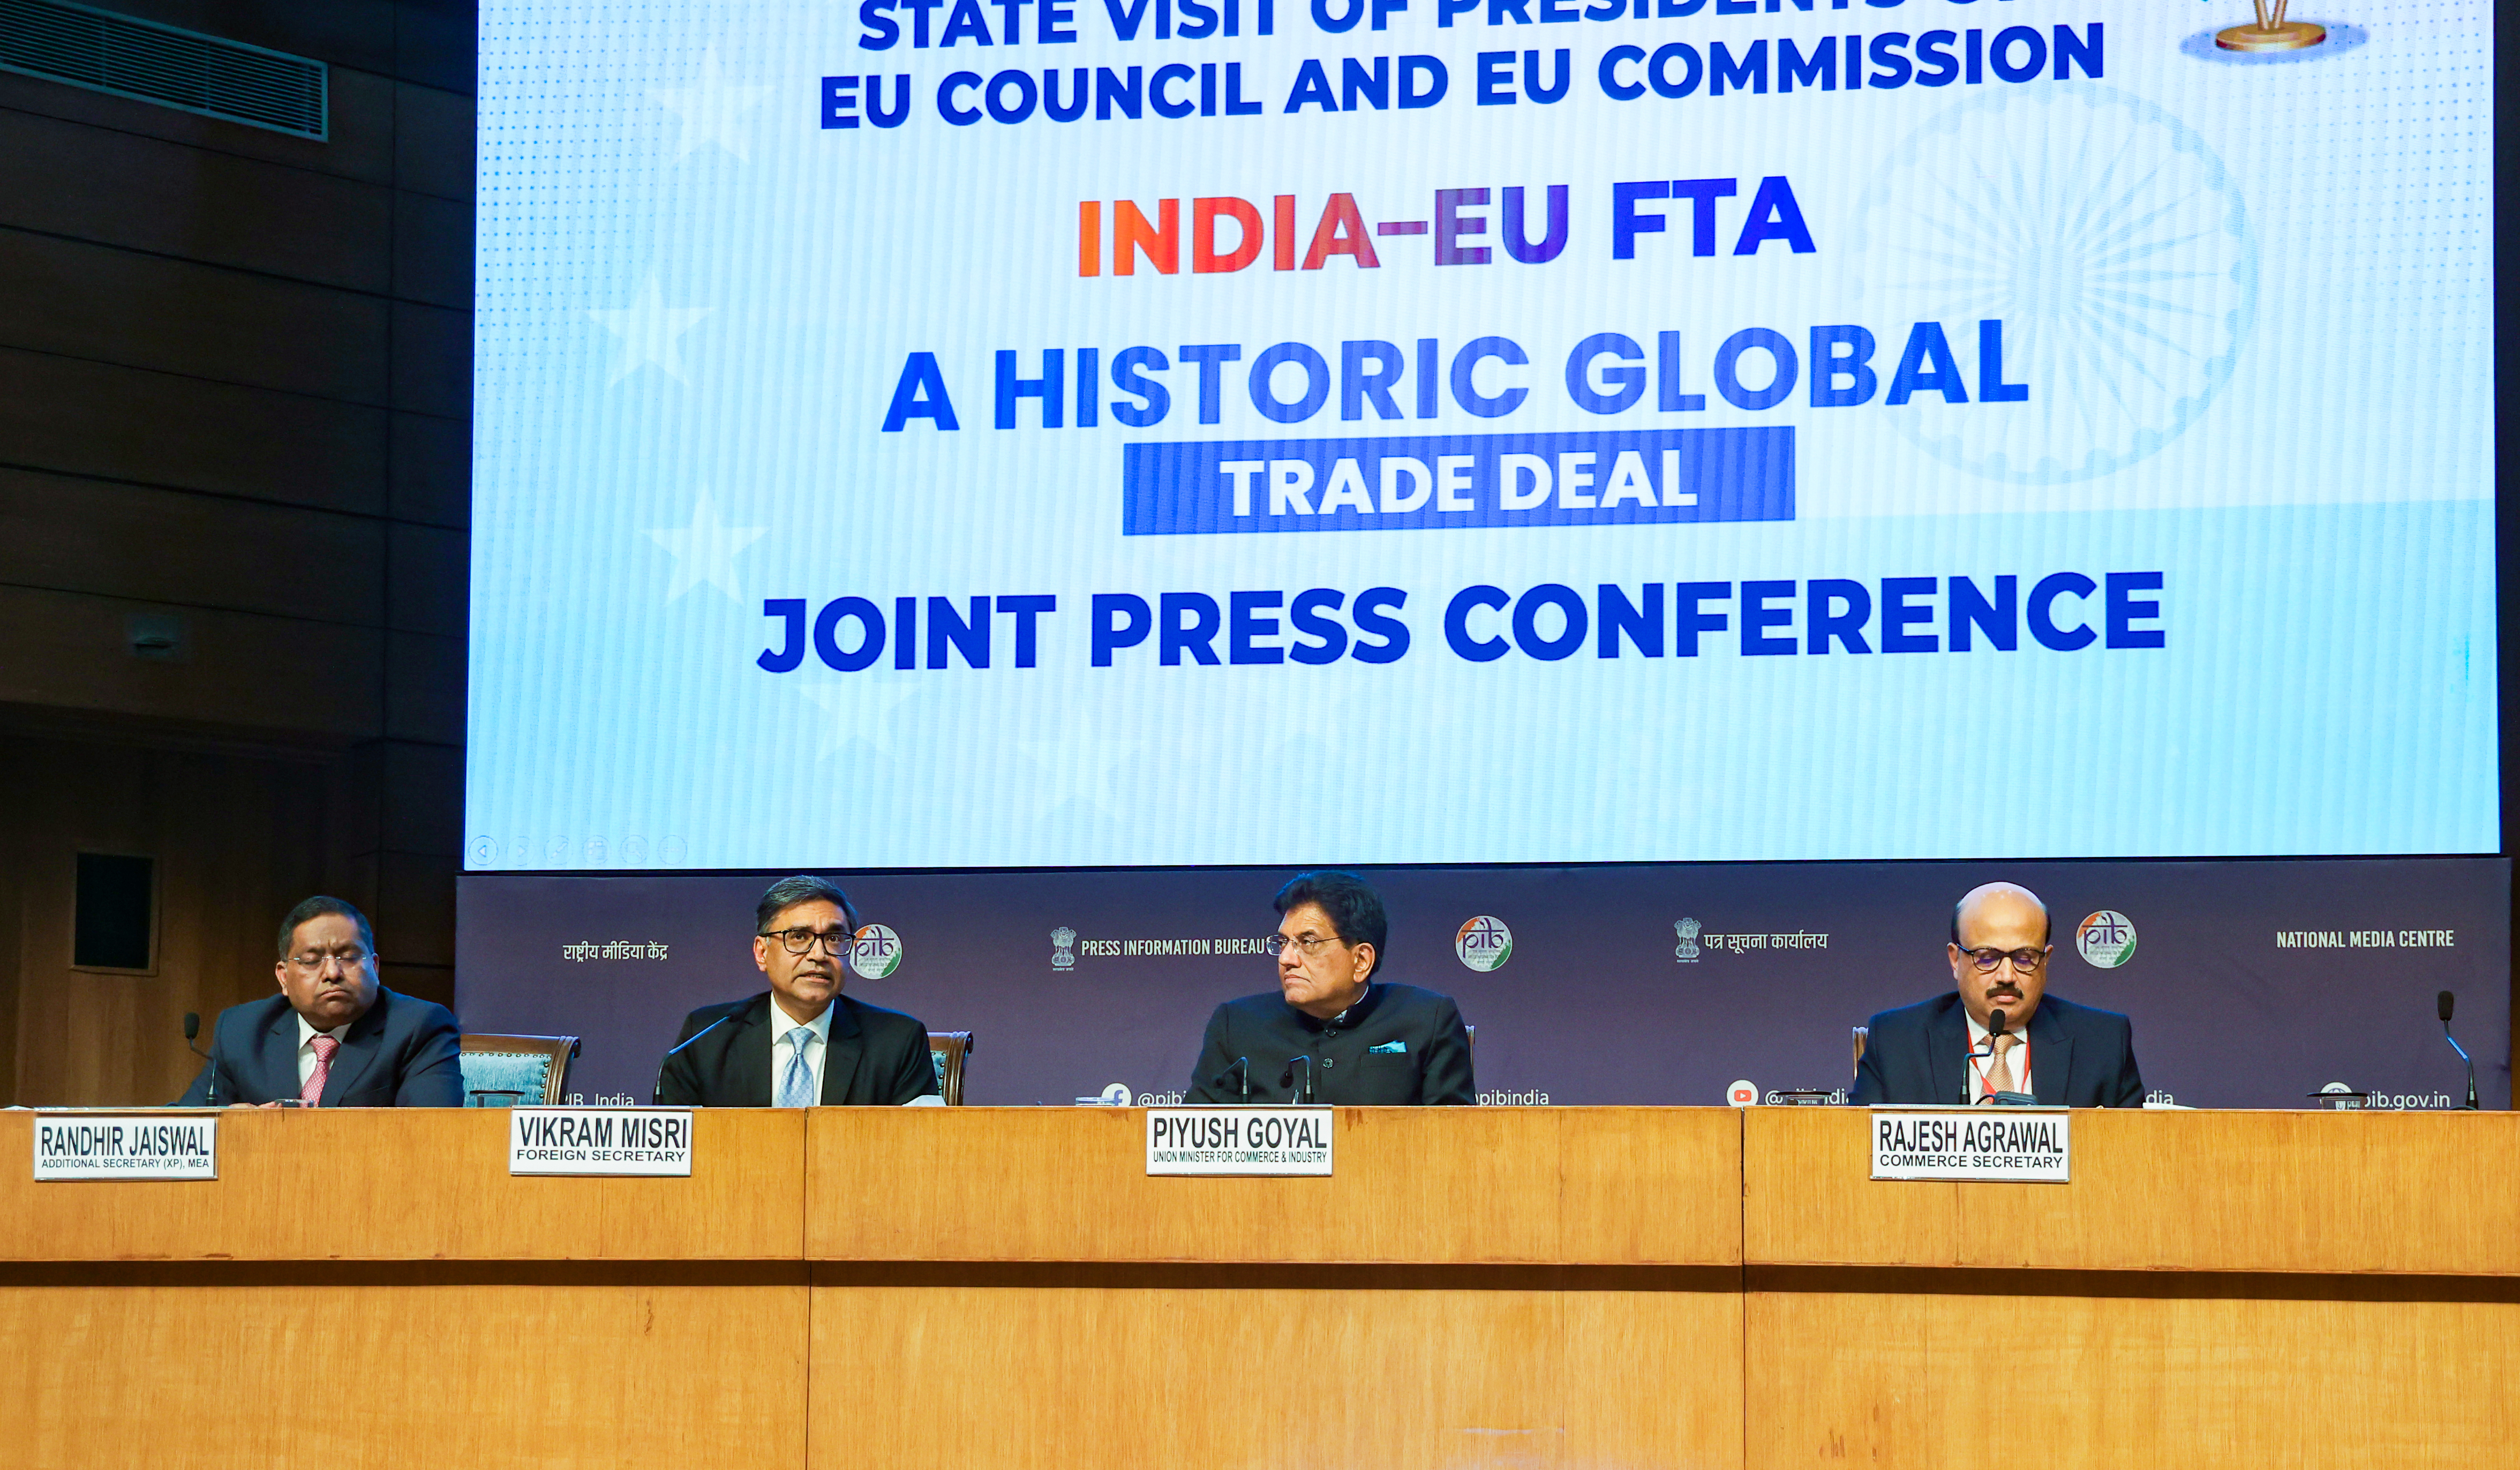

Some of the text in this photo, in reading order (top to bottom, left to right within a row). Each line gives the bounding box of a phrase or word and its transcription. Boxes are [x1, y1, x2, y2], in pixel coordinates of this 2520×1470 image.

[858, 0, 1077, 51] STATE
[821, 22, 2104, 130] EU COUNCIL AND EU COMMISSION
[1612, 176, 1817, 260] FTA
[881, 319, 2029, 432] A HISTORIC GLOBAL
[1220, 450, 1698, 516] TRADE DEAL
[756, 572, 2165, 673] JOINT PRESS CONFERENCE
[562, 940, 669, 962] राष्ट्रीय मीडिया केंद्र
[1081, 939, 1265, 956] PRESS INFORMATION BUREAU
[1704, 929, 1829, 954] पत्र सूचना कार्यालय
[2277, 930, 2454, 948] NATIONAL MEDIA CENTRE
[1475, 1090, 1549, 1106] pibindia
[42, 1126, 209, 1156] RANDHIR JAISWAL
[519, 1117, 687, 1149] VIKRAM MISRI
[1154, 1117, 1327, 1149] PIYUSH GOYAL
[1880, 1120, 2063, 1153] RAJESH AGRAWAL
[42, 1159, 209, 1170] ADDITIONAL SECRETARY (XP), MEA
[517, 1150, 685, 1162] FOREIGN SECRETARY
[1154, 1151, 1327, 1163] UNION MINISTER FOR COMMERCE & INDUSTRY
[1880, 1154, 2063, 1168] COMMERCE SECRETARY
